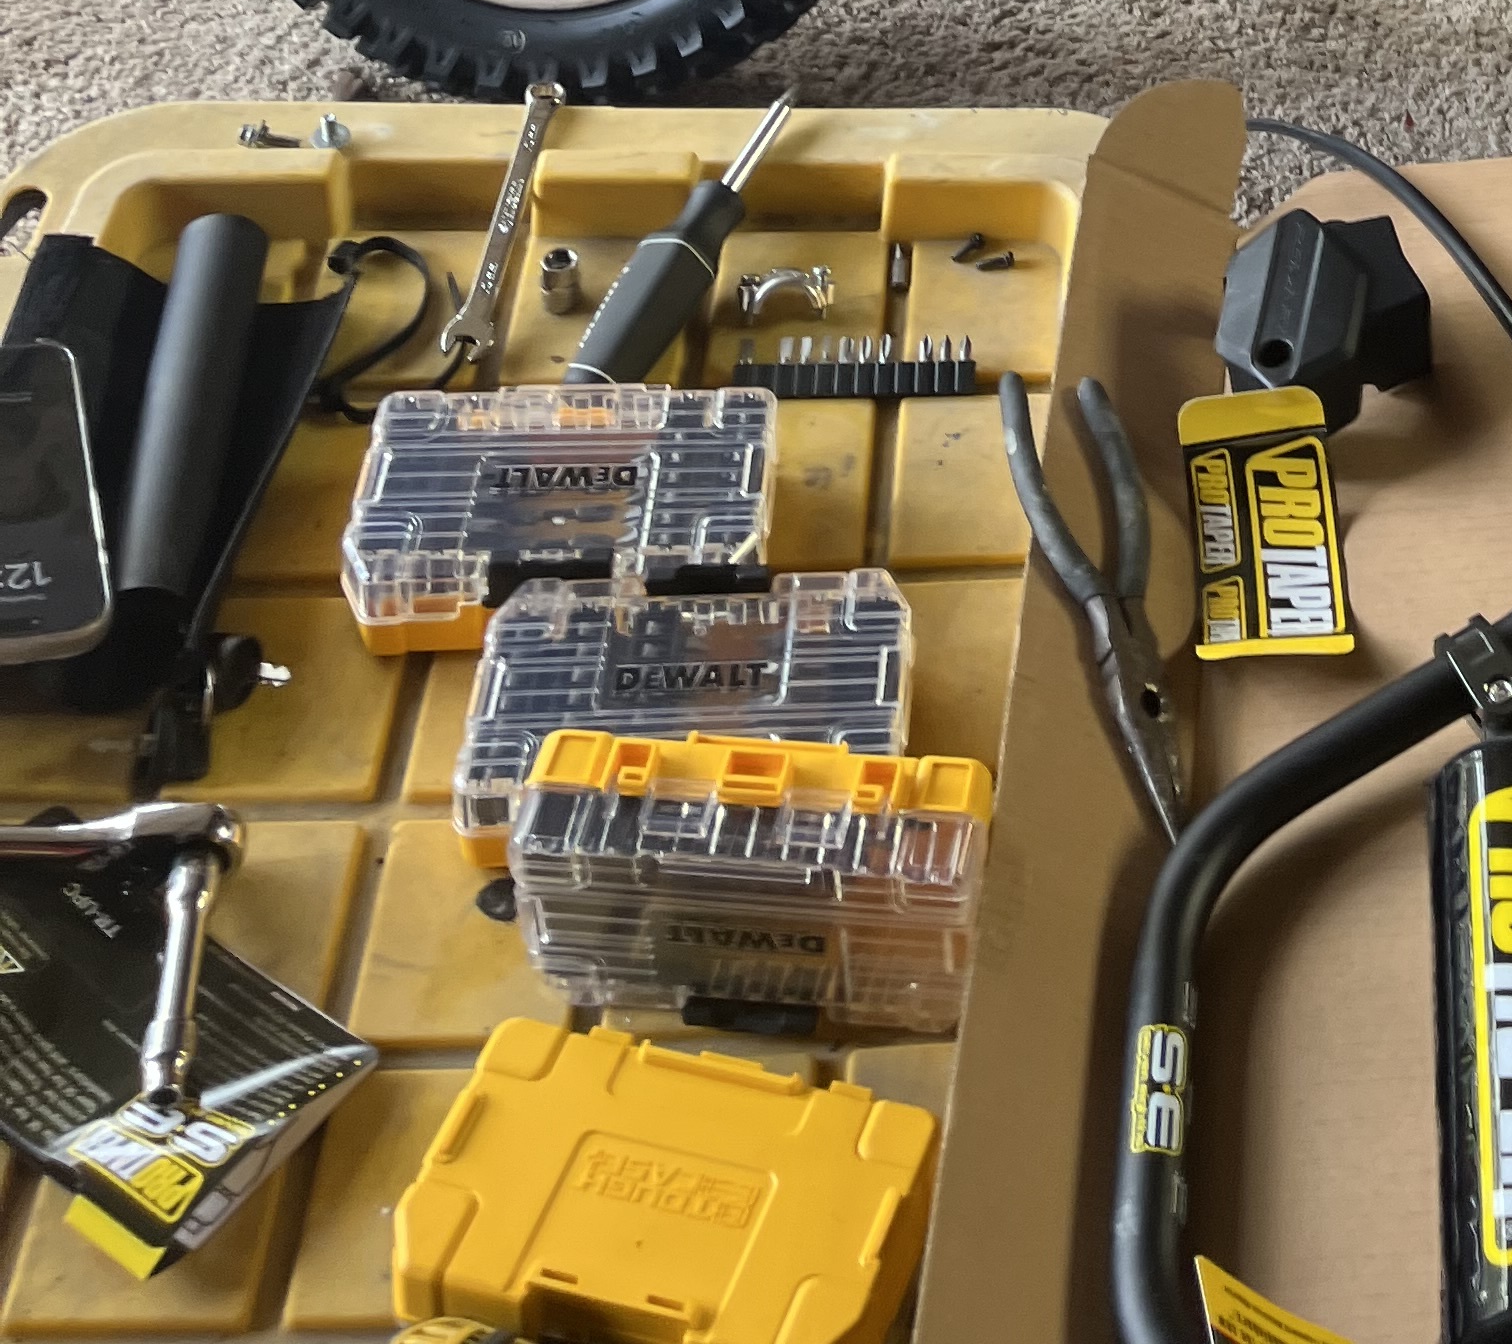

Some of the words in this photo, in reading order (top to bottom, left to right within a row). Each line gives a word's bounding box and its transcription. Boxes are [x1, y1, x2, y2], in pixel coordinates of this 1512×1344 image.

[490, 463, 639, 494] DEWALT
[1194, 458, 1239, 569] PROTAPER
[614, 661, 770, 694] DEWALT
[663, 924, 828, 955] DEWALT
